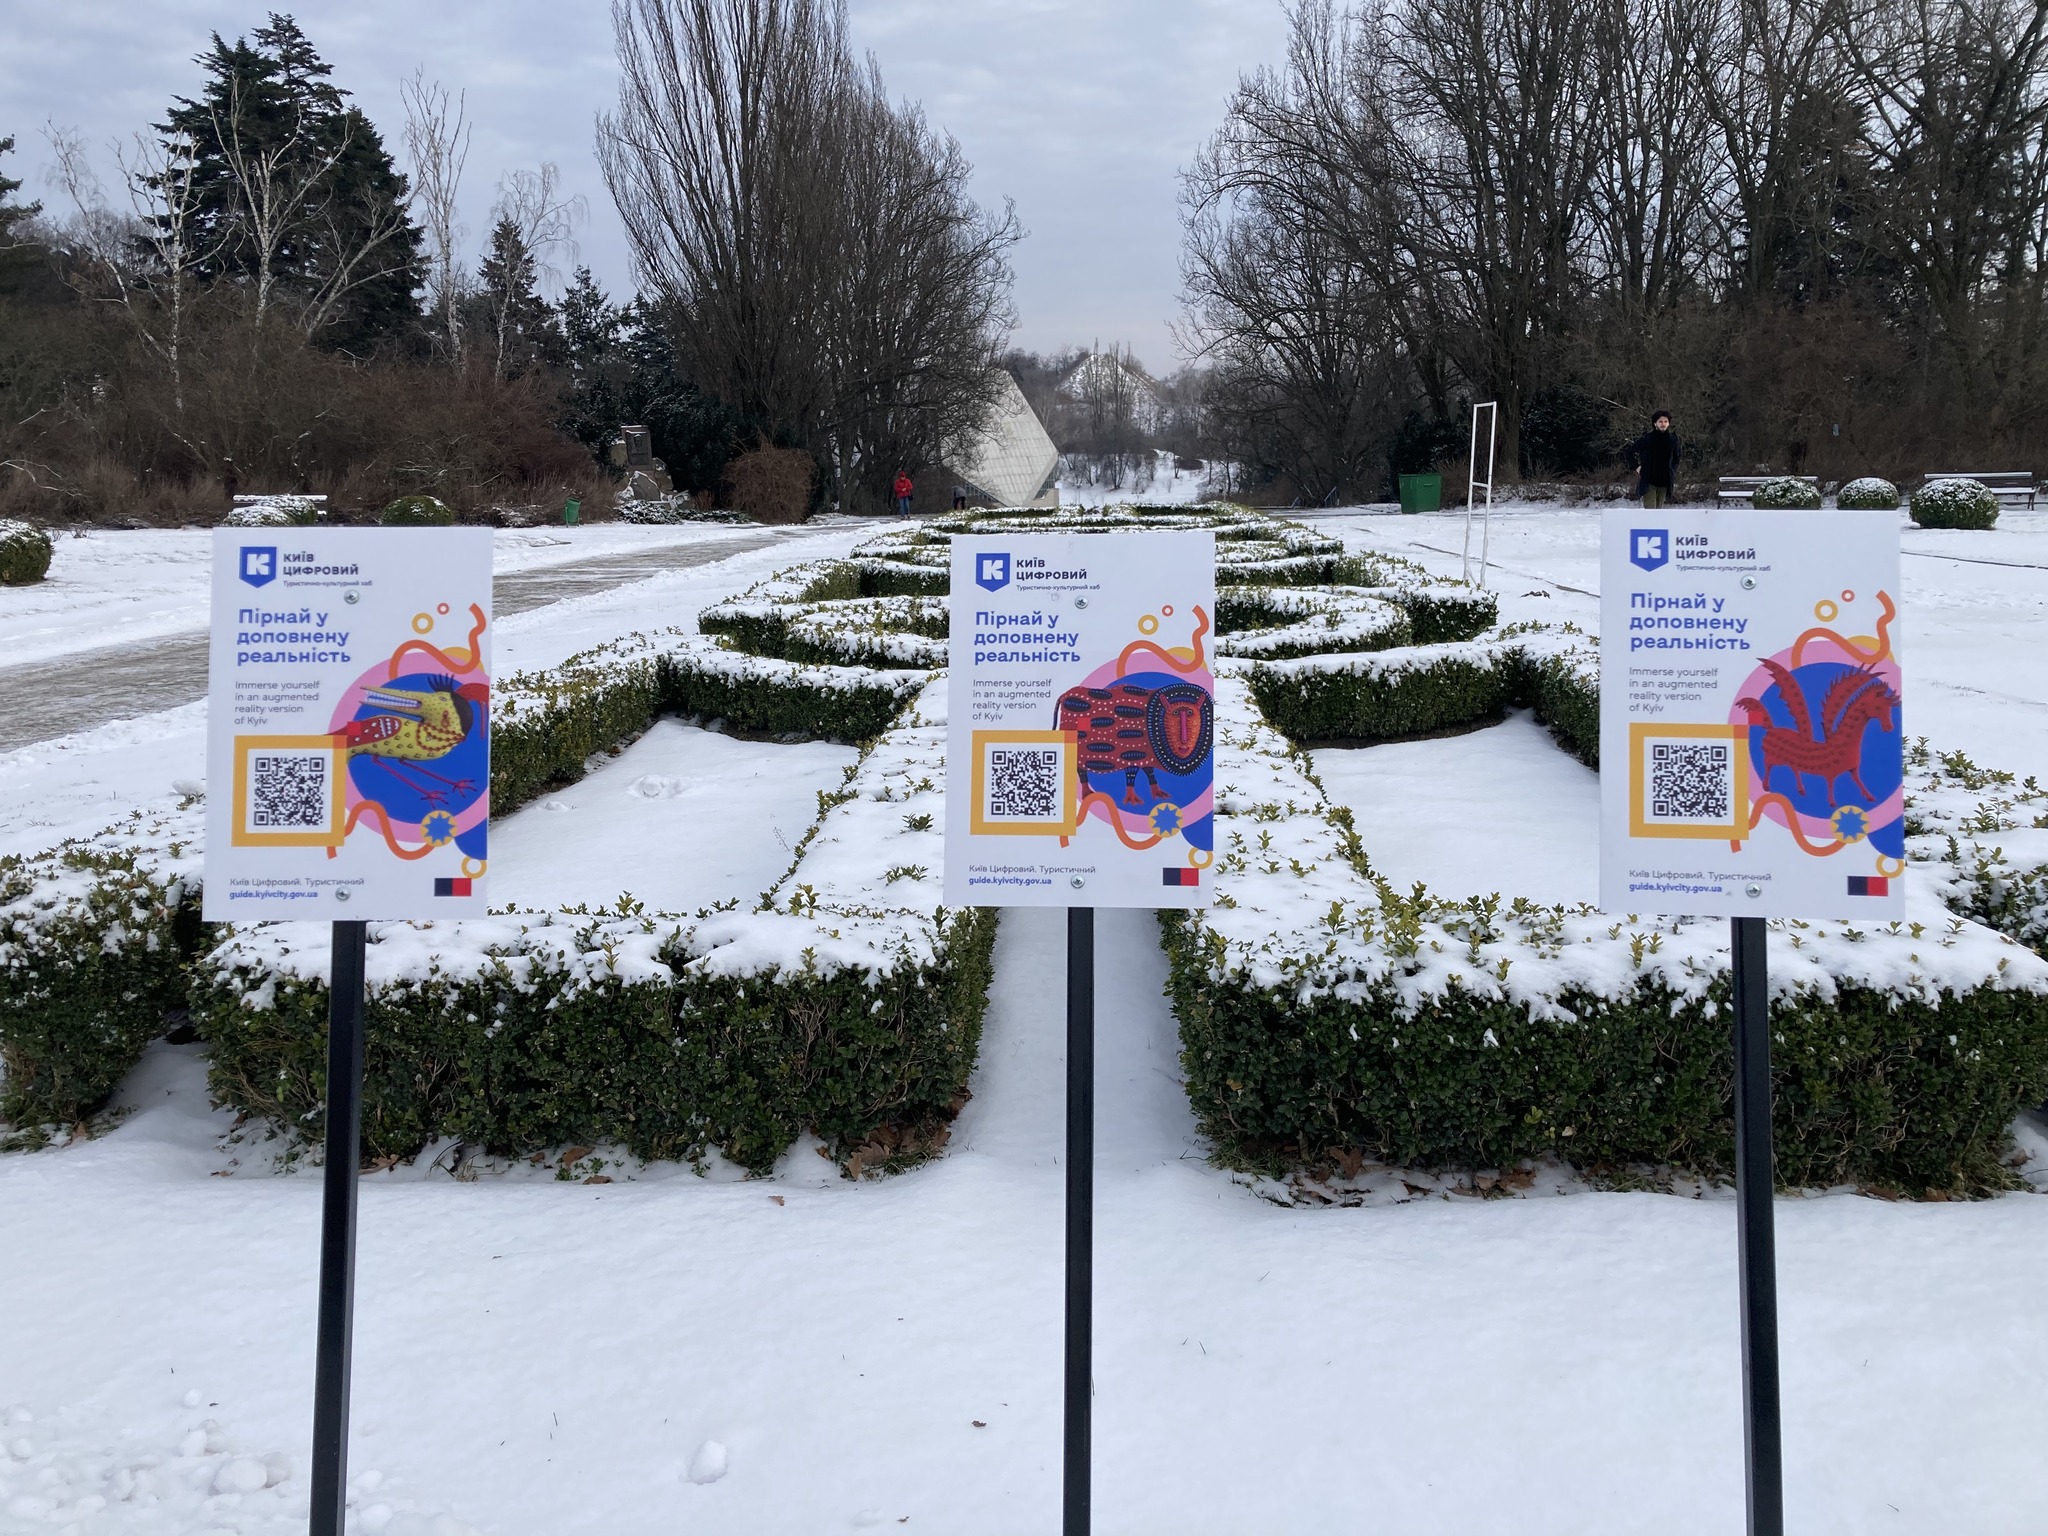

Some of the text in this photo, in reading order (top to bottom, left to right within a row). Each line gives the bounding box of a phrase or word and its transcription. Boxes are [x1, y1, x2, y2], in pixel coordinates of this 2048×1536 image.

[1676, 534, 1708, 546] КИЇВ
[284, 551, 314, 562] КИЇВ
[1676, 548, 1755, 560] ЦИФРОВИЙ
[1017, 557, 1045, 568] КИЇВ
[283, 564, 358, 576] ЦИФРОВИЙ
[1016, 569, 1087, 581] ЦИФРОВИЙ
[1631, 592, 1725, 613] Пірнай у
[239, 608, 328, 627] Пірнай у
[976, 611, 1059, 629] Пірнай у
[1629, 617, 1748, 634] доповнену
[237, 632, 349, 647] доповнену
[974, 633, 1079, 648] доповнену
[1631, 633, 1750, 652] реальність
[238, 647, 351, 666] реальність
[975, 648, 1080, 665] реальність
[1629, 667, 1718, 678] Immerse yourself
[281, 681, 320, 691] yourself
[1015, 679, 1052, 688] yourself
[1629, 679, 1639, 687] in
[1658, 680, 1717, 690] augmented
[235, 693, 244, 701] in
[262, 693, 319, 703] augmented
[973, 690, 981, 698] in
[998, 691, 1051, 700] augmented
[1629, 691, 1701, 702] reality version
[235, 705, 266, 715] reality
[973, 701, 1001, 711] reality
[1629, 703, 1664, 714] of Kyiv
[234, 716, 268, 727] of Kyiv
[972, 712, 1003, 722] of Kyiv
[1039, 866, 1095, 875] Туристичний
[1629, 870, 1650, 878] Київ
[1708, 872, 1771, 881] Туристичний
[230, 878, 249, 886] Київ
[305, 878, 364, 887] Туристичний
[969, 876, 1051, 886] guide.kyivcity.gov.ua
[1629, 881, 1722, 893] guide.kyivcity.gov.ua
[229, 890, 318, 900] guide.kyivcity.gov.ua
